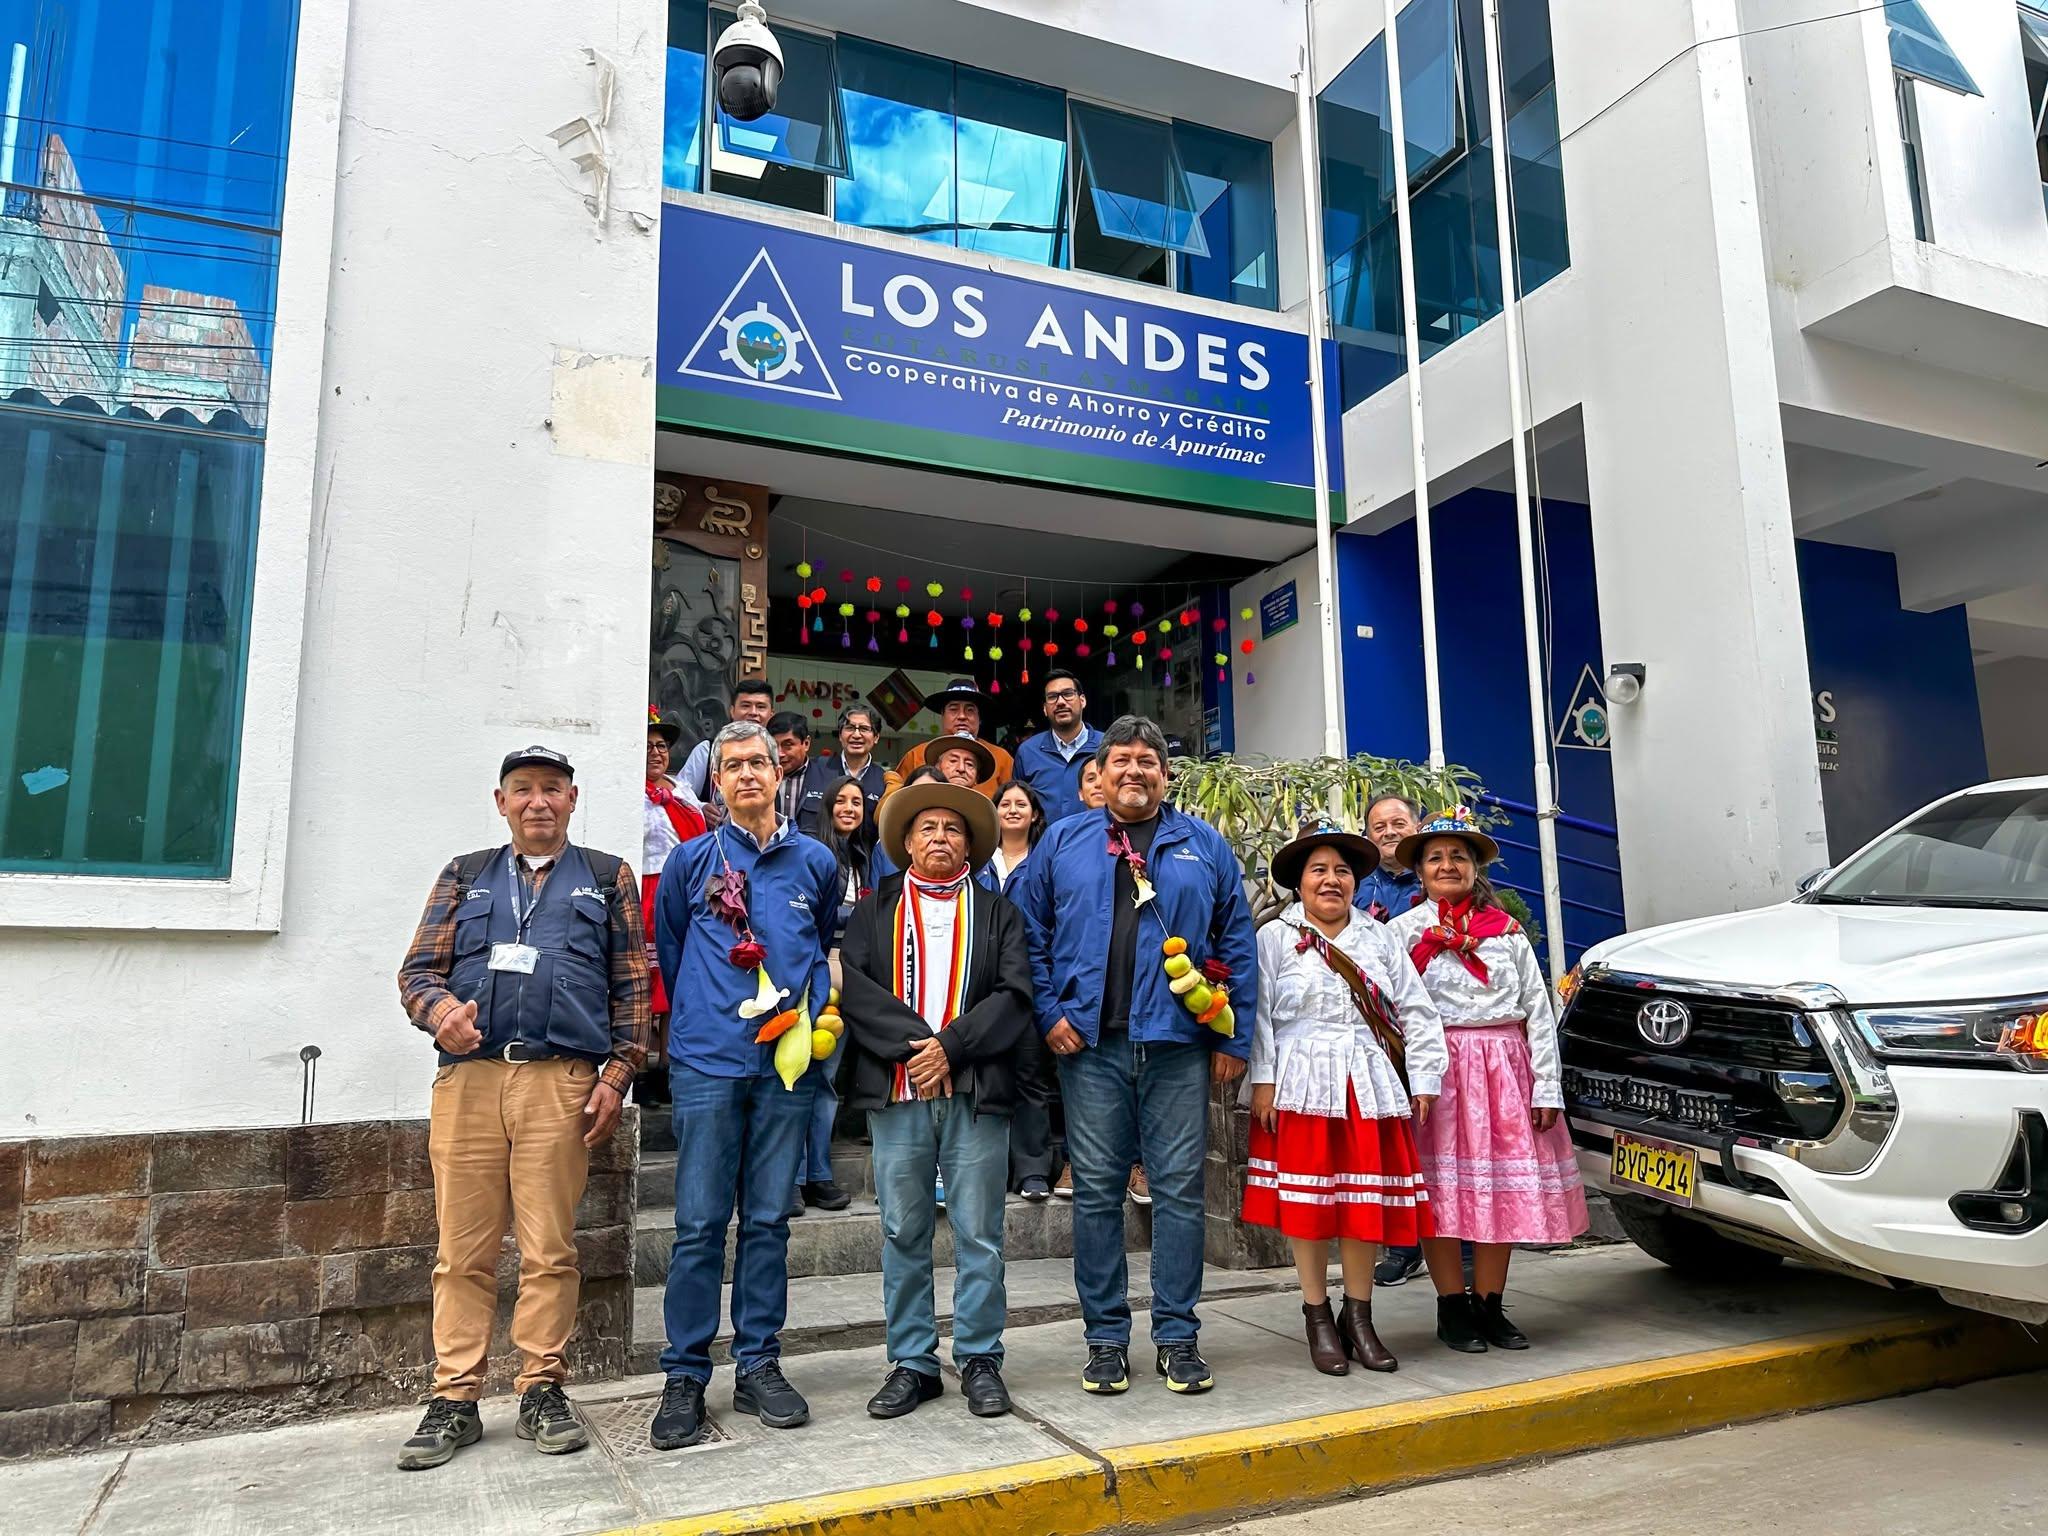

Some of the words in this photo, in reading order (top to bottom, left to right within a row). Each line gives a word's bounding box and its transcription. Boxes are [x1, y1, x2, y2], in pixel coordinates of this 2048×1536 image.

[841, 263, 988, 338] LOS
[1025, 304, 1270, 390] ANDES
[843, 326, 1049, 377] COTARUSI
[845, 354, 1019, 399] Cooperativa
[1028, 387, 1058, 406] de
[1068, 394, 1150, 421] Ahorro
[1159, 411, 1171, 428] y
[1179, 412, 1266, 440] Crédito
[1000, 407, 1126, 442] Patrimonio
[1132, 430, 1158, 447] de
[1160, 434, 1266, 465] Apurímac
[784, 678, 859, 702] ANDES
[1616, 1146, 1688, 1194] BYQ-914
